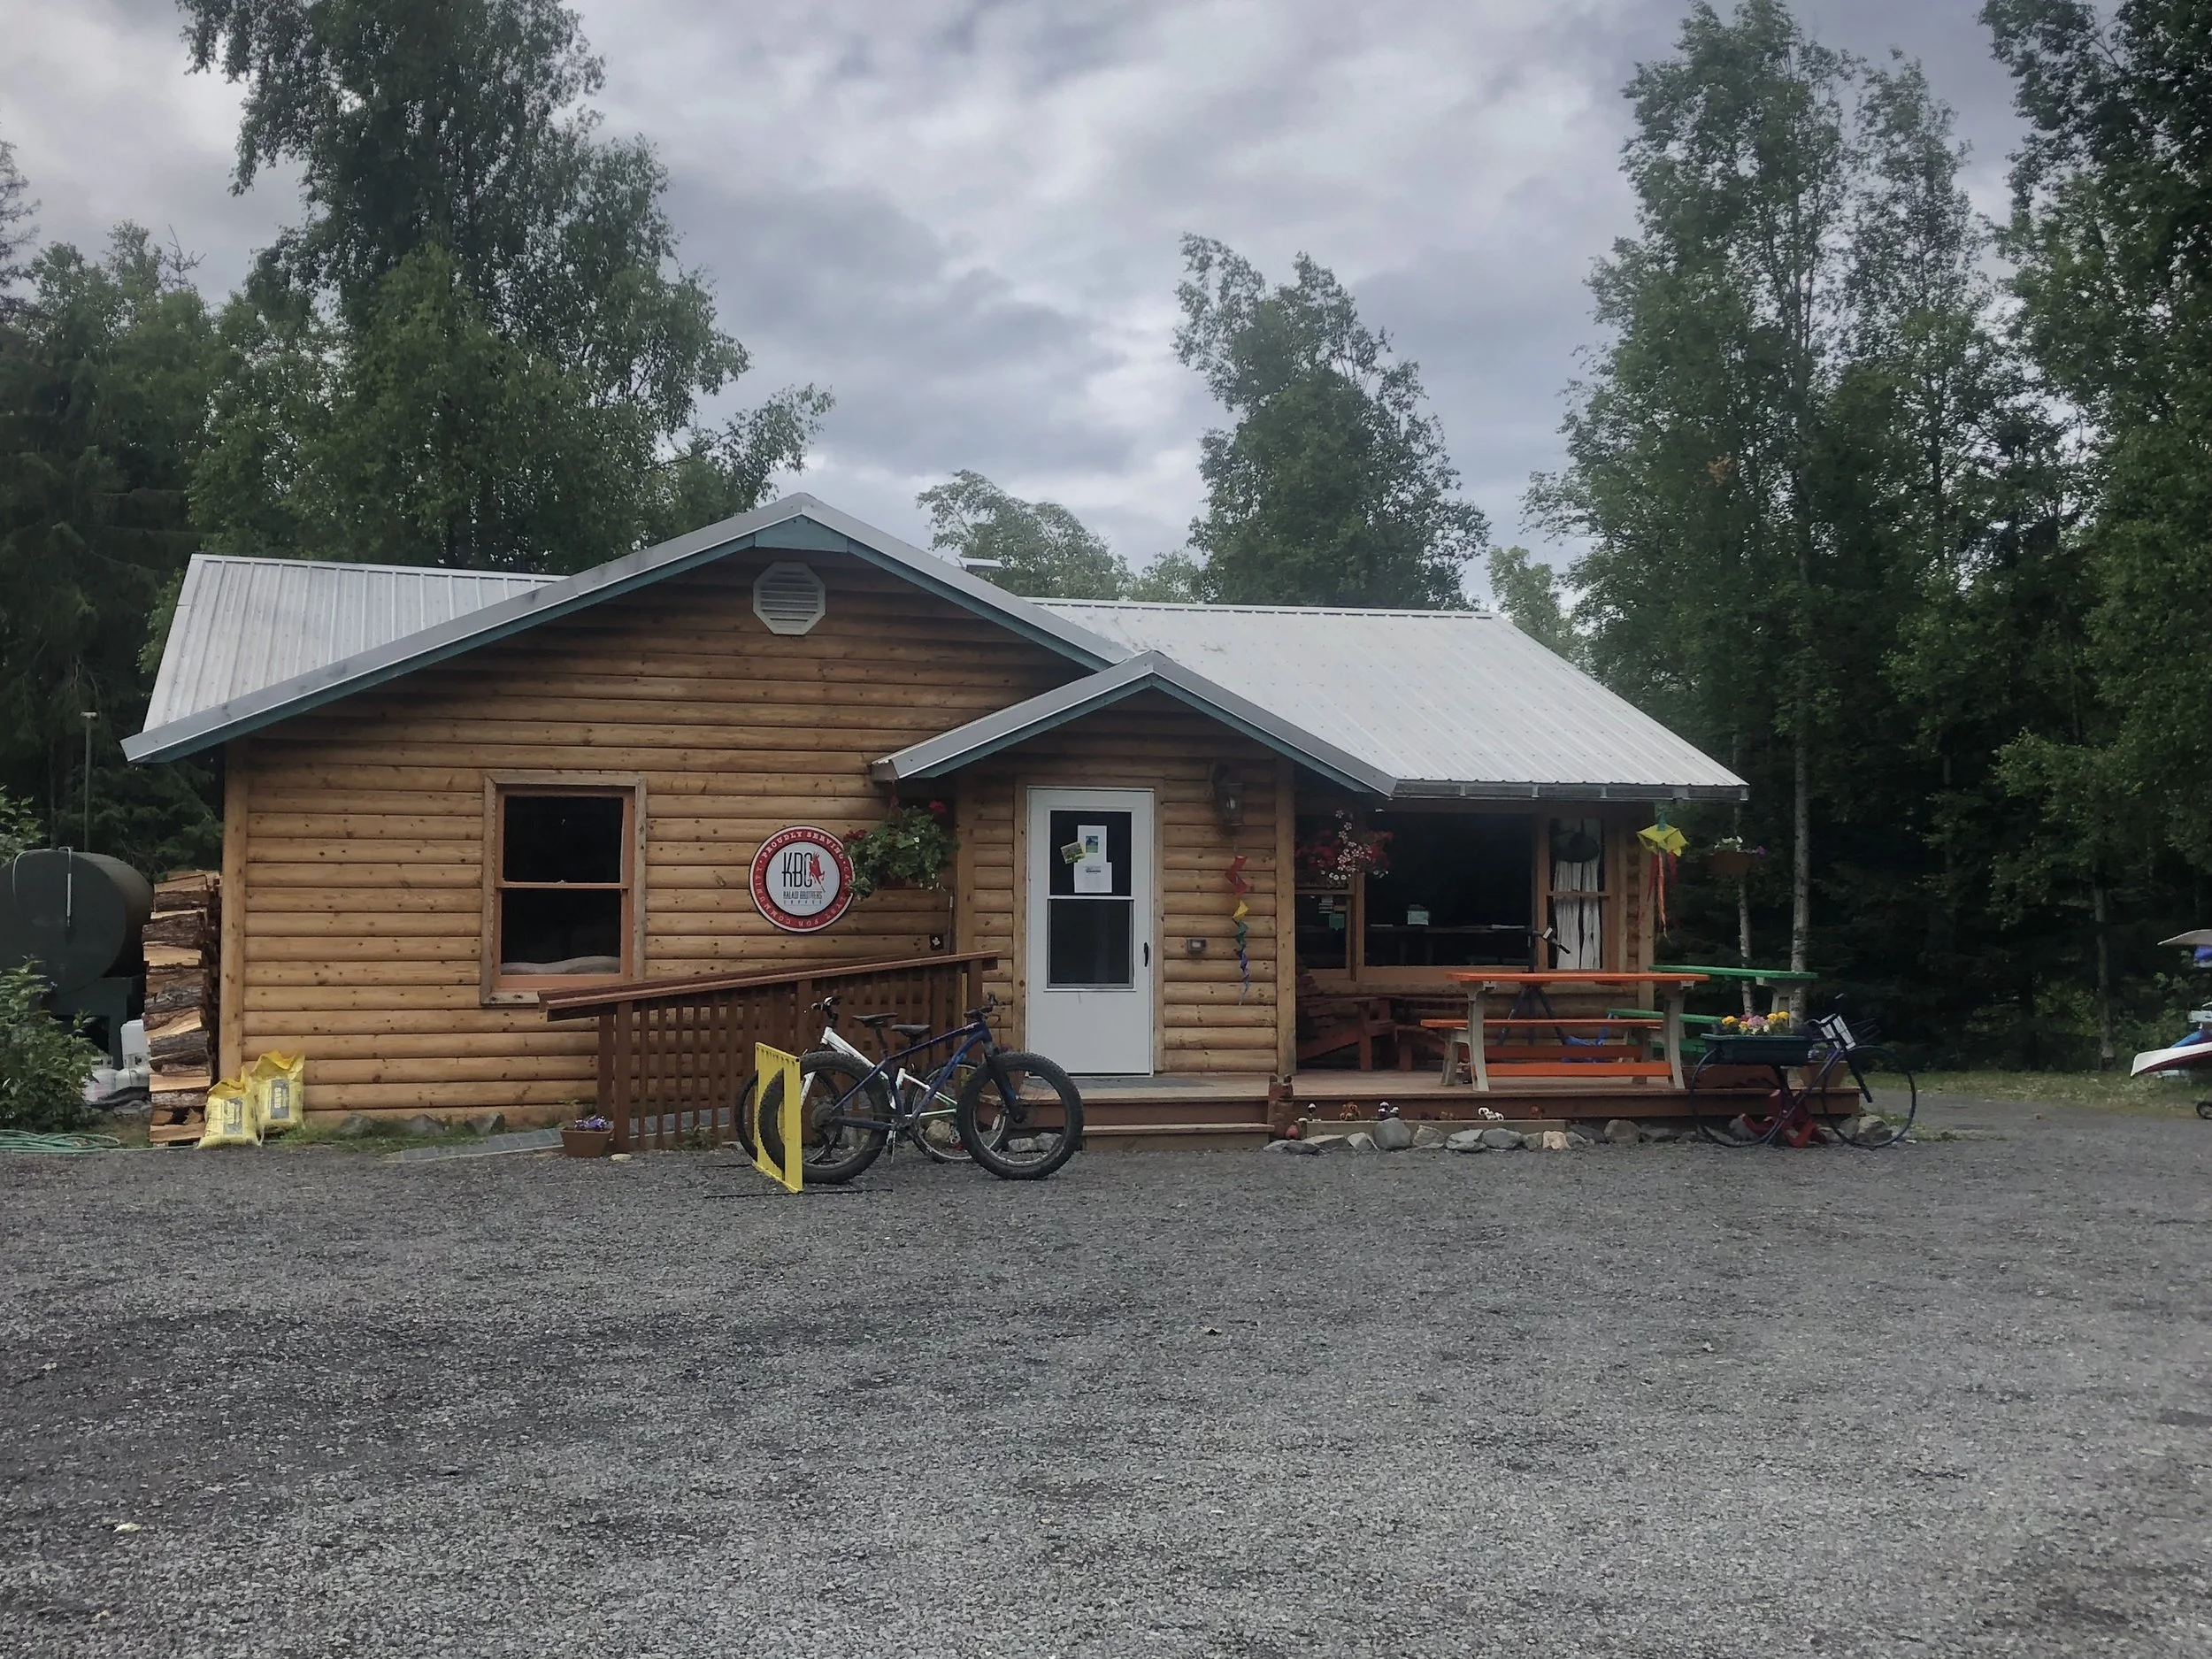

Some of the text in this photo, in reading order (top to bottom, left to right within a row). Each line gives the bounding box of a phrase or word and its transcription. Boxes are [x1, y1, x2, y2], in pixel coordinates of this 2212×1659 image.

[762, 831, 844, 859] PROUDLY SERVING
[781, 852, 813, 888] KBC
[755, 866, 852, 927] CALYST FOR COMMUNITY
